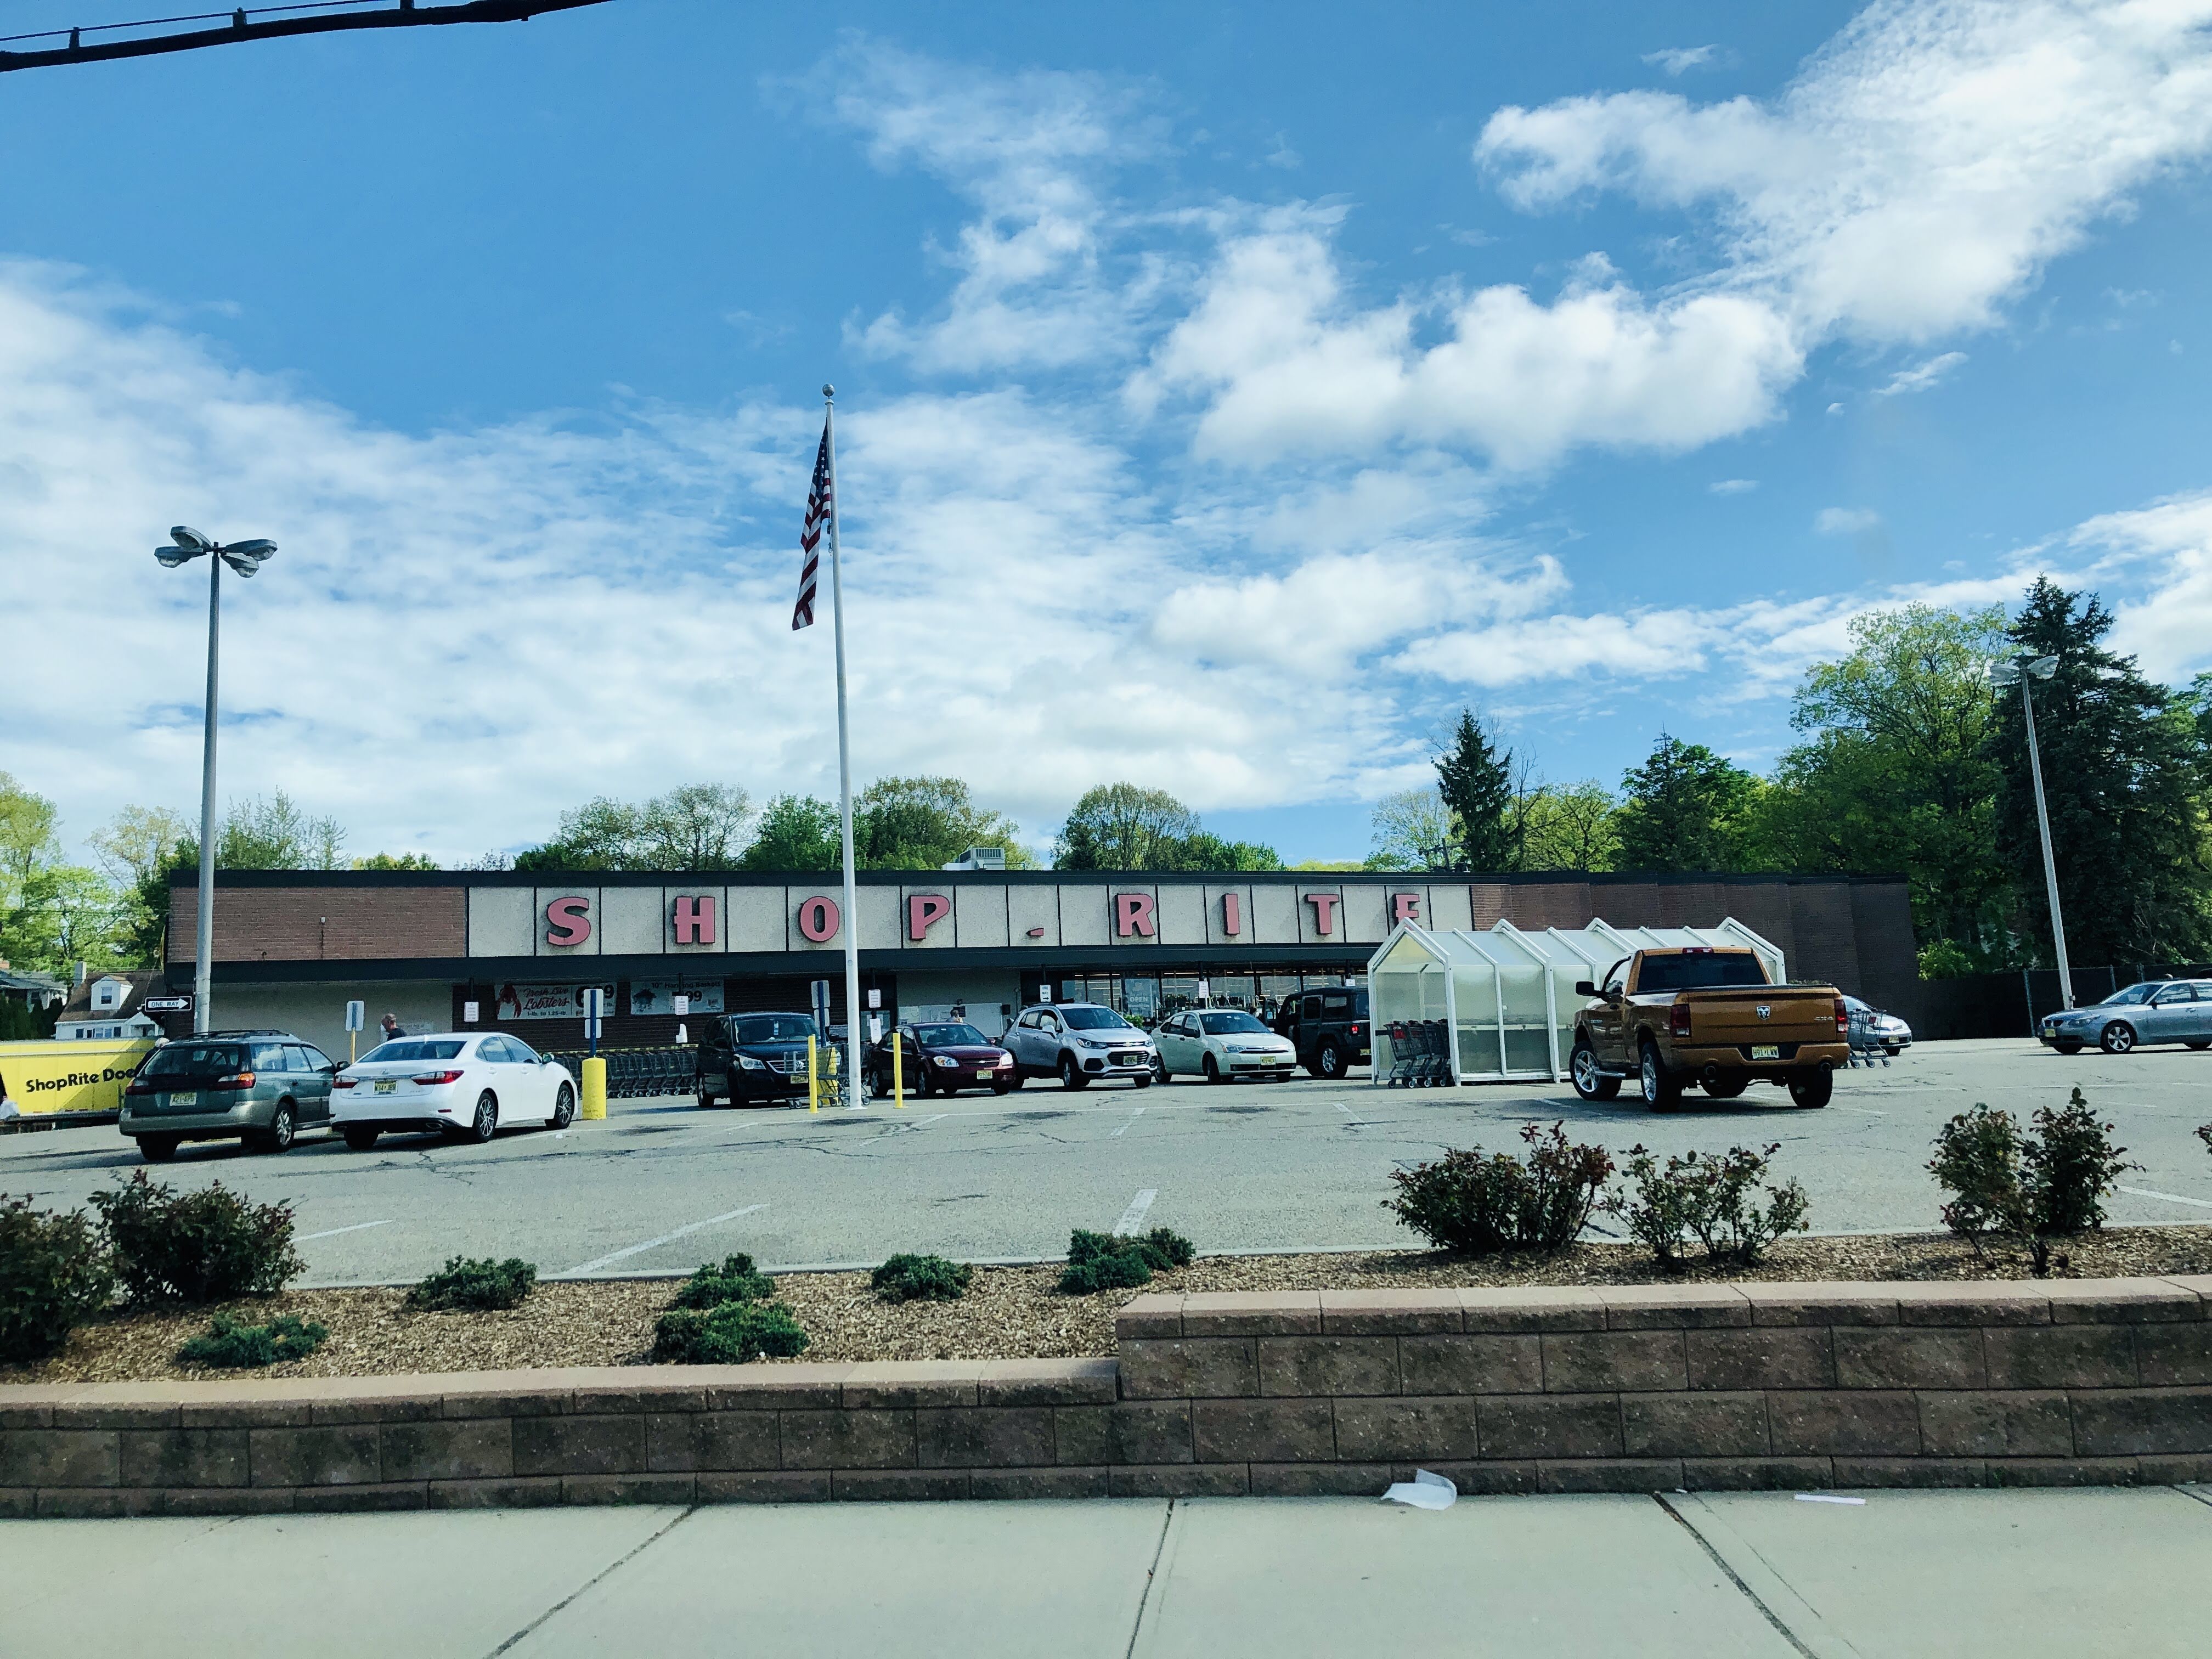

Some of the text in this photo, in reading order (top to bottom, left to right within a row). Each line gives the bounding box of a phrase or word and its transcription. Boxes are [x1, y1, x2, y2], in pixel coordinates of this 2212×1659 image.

[523, 986, 569, 998] Fresh Live
[523, 996, 570, 1011] Lobsters
[26, 1073, 99, 1093] ShopRite
